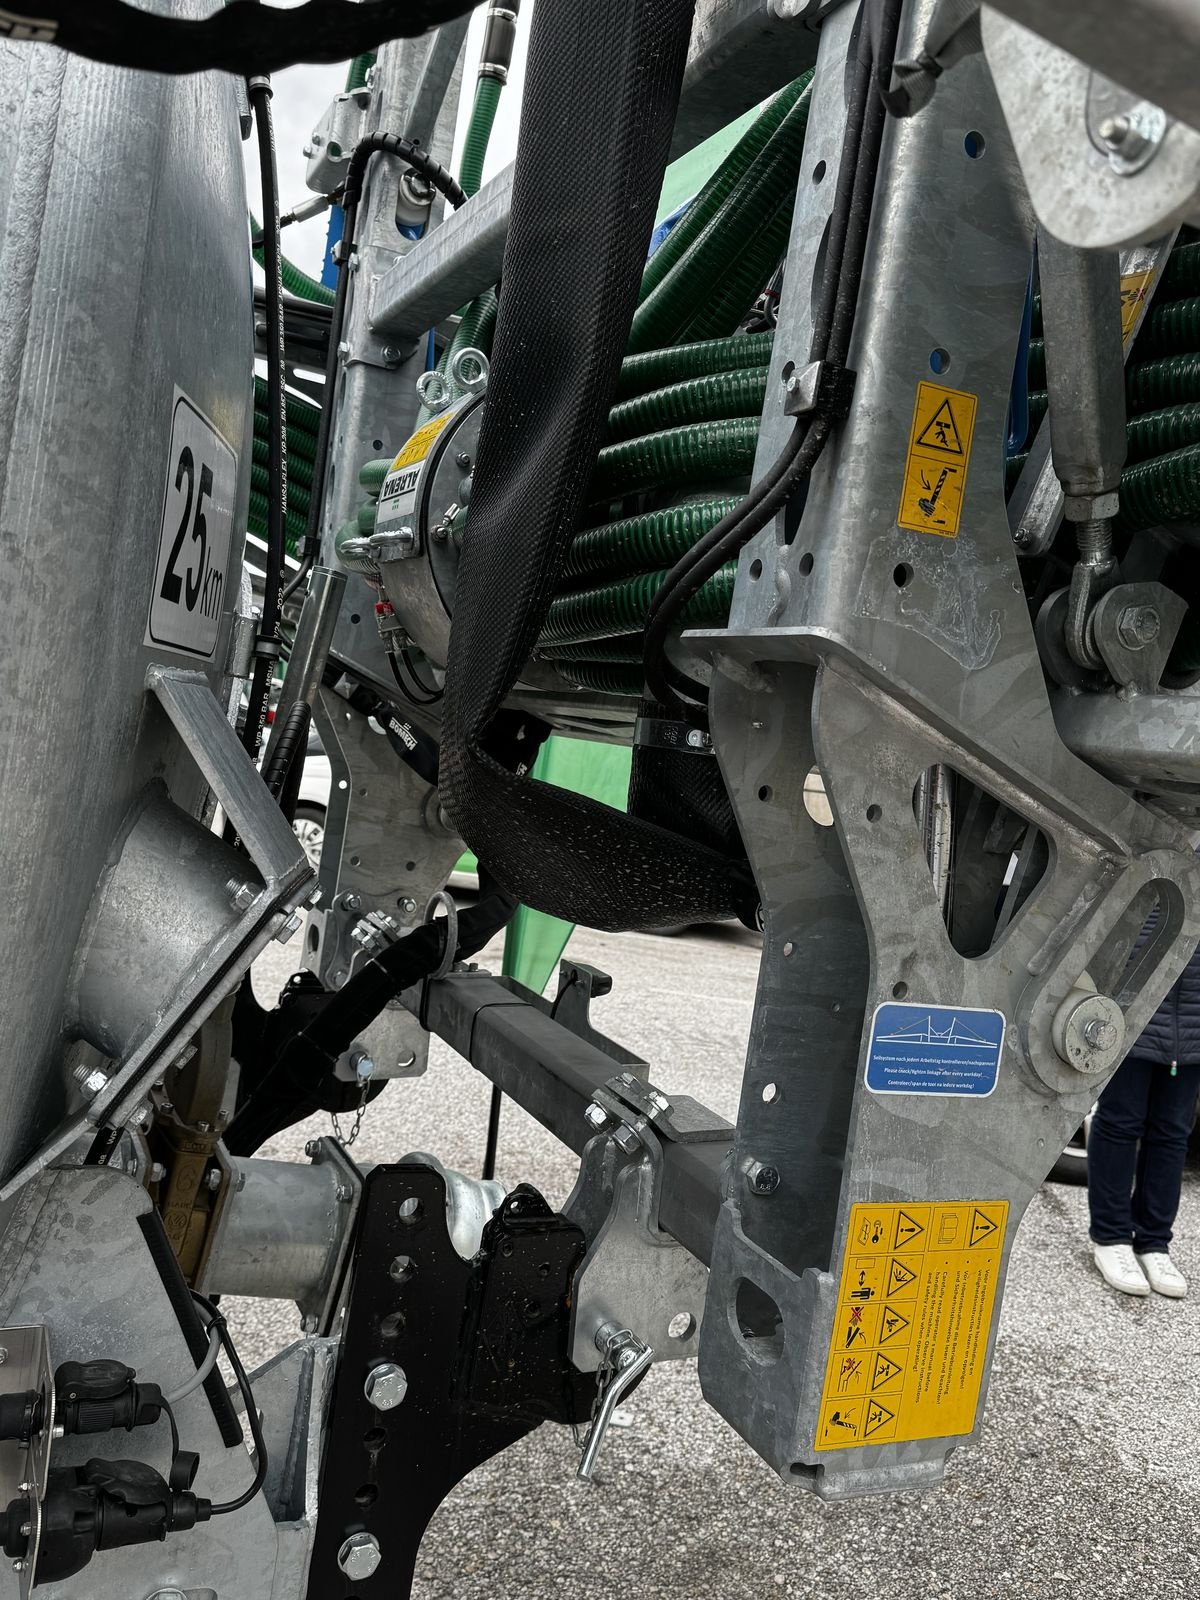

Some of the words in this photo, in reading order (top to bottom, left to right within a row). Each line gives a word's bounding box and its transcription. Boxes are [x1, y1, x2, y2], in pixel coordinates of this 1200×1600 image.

[280, 408, 286, 421] EN
[384, 468, 420, 496] ALRENA
[160, 446, 214, 612] 25
[200, 546, 223, 620] km
[255, 732, 262, 746] WP
[389, 720, 416, 750] BOMECH
[922, 1286, 931, 1304] safety
[931, 1271, 940, 1298] handling
[938, 1271, 947, 1298] Carefully
[921, 1340, 929, 1366] Observe
[915, 1367, 925, 1403] instructions
